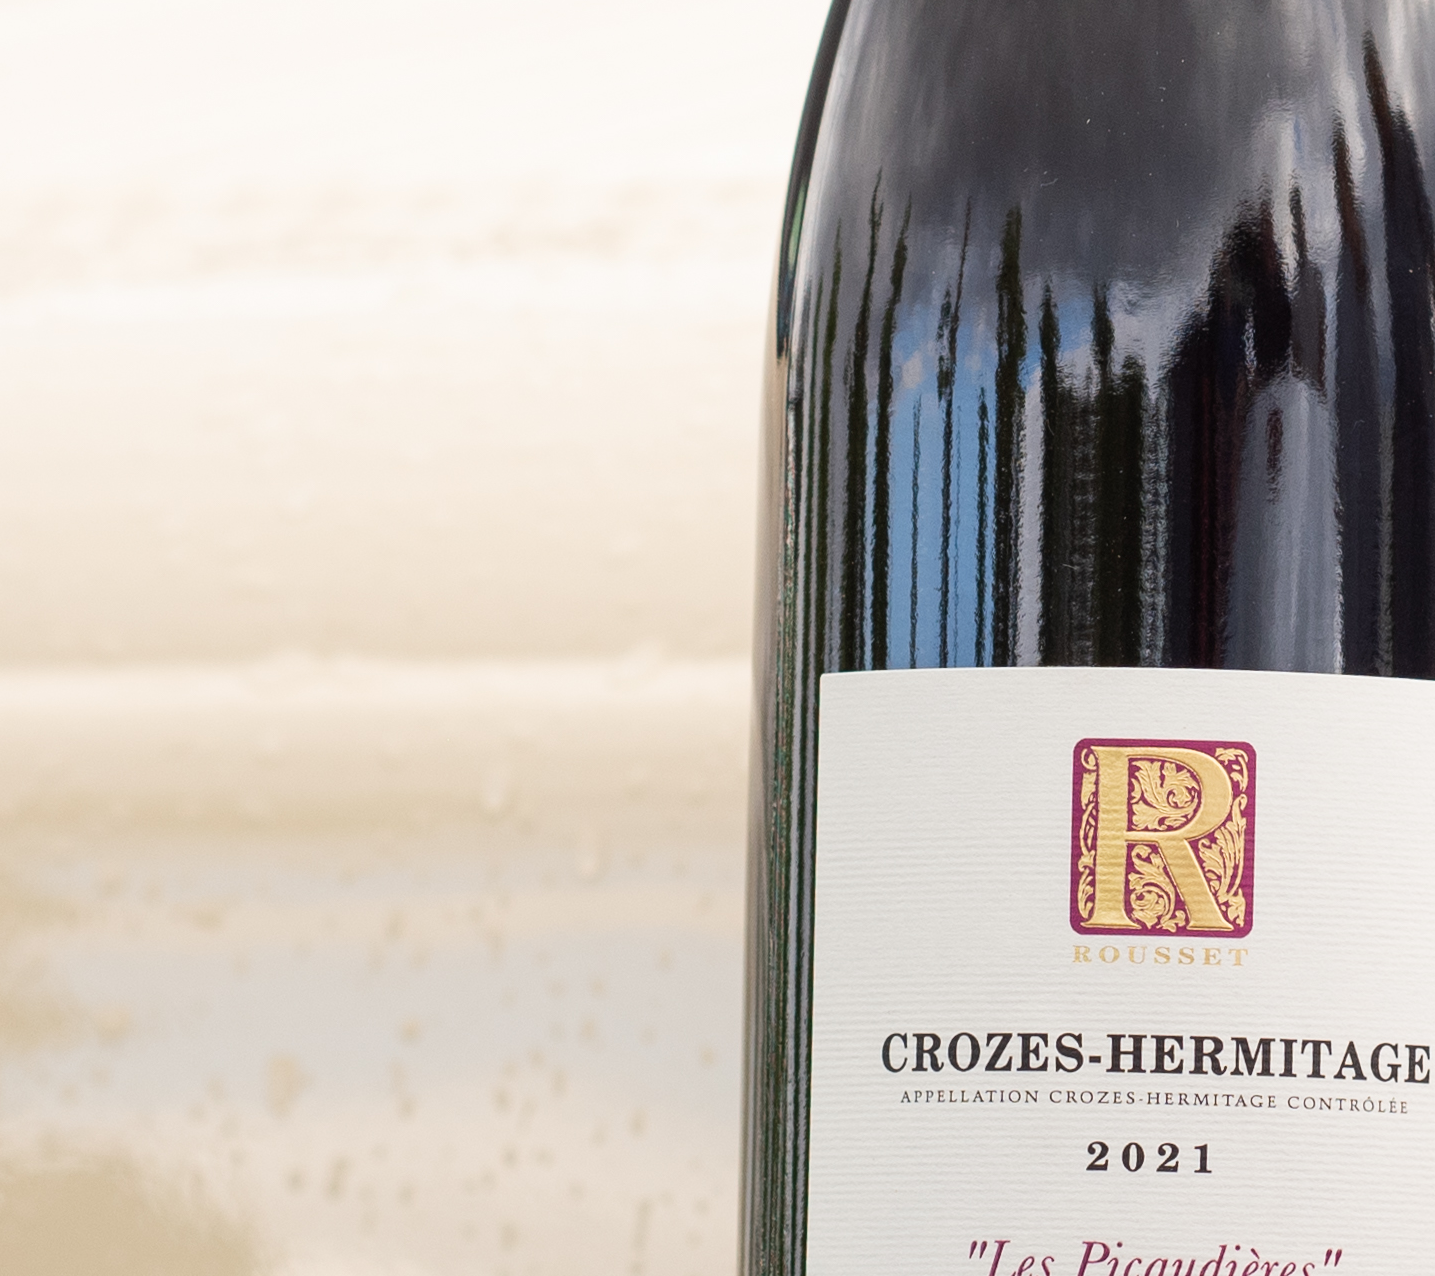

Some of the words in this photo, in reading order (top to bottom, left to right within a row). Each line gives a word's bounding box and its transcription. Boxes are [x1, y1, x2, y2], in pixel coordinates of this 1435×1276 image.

[1079, 744, 1236, 933] R
[1071, 944, 1251, 968] ROUSSET
[881, 1031, 1433, 1085] CROZES-HERMITAGE
[900, 1088, 1041, 1106] APPELLATION
[1049, 1089, 1279, 1110] CROZES-HERMITAGE
[1287, 1094, 1411, 1116] CONTRÔLÉE
[1085, 1140, 1215, 1176] 2021
